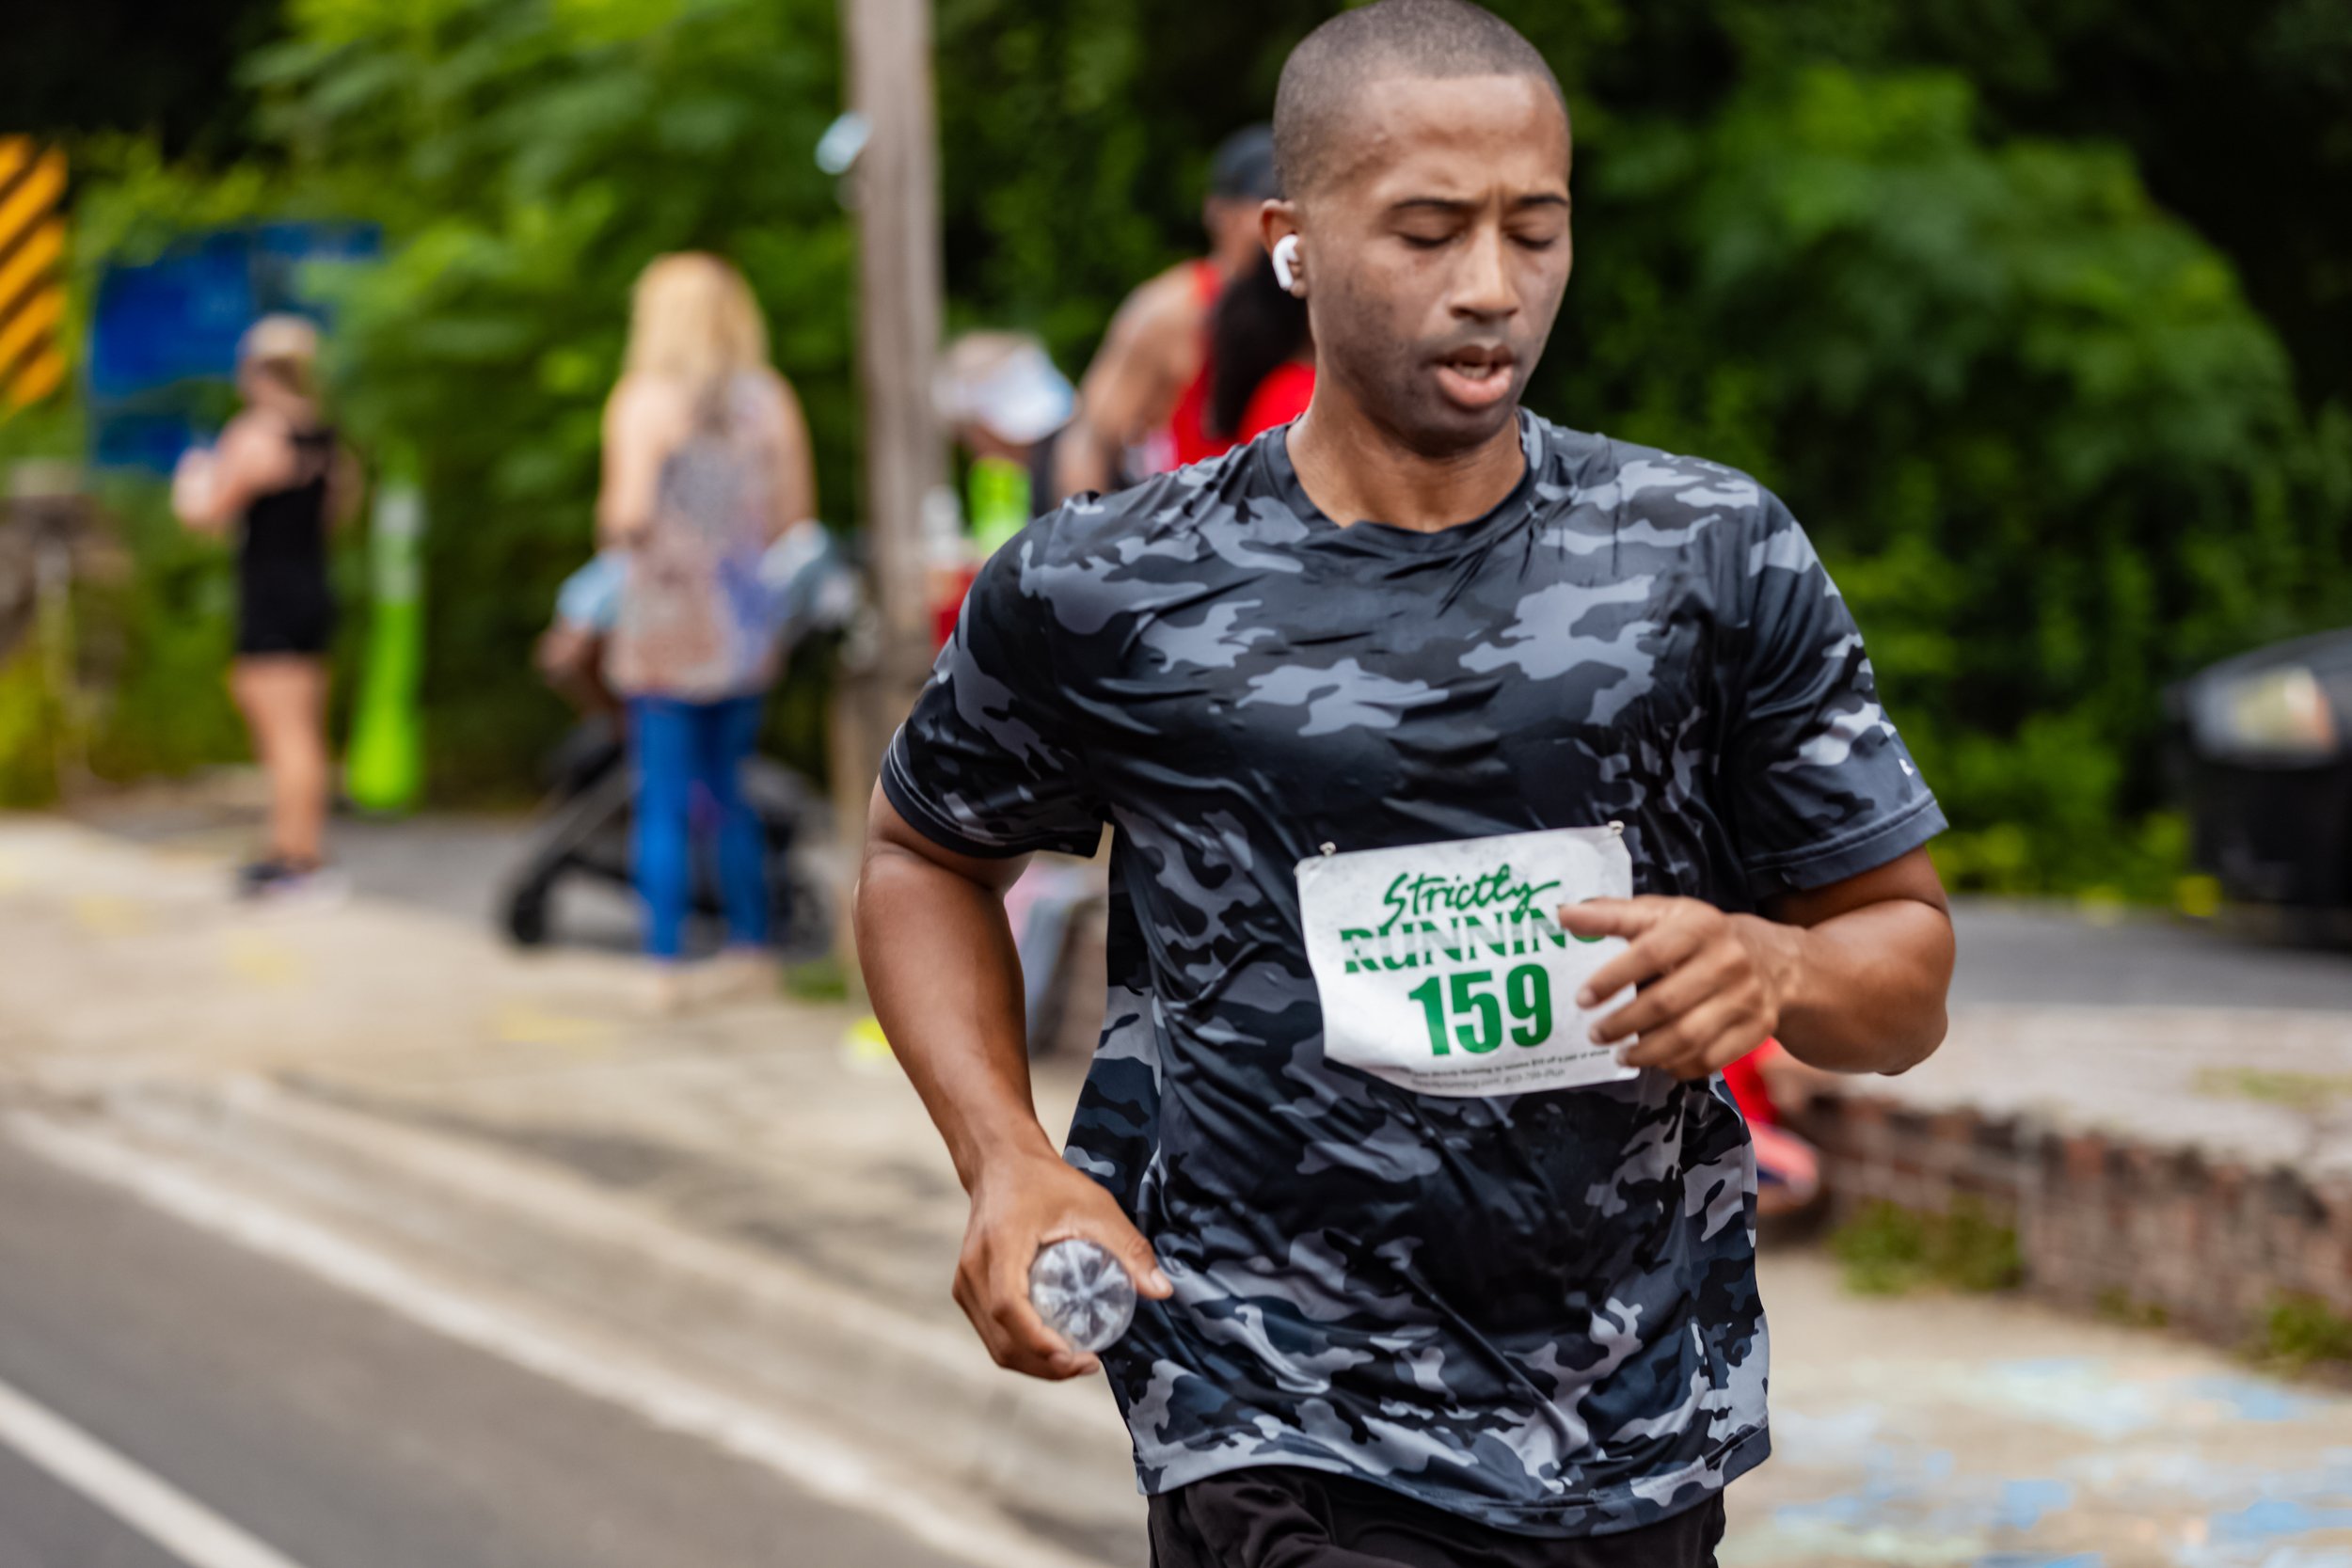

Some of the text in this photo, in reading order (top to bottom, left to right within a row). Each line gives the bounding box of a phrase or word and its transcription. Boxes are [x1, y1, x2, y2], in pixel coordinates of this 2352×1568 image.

[1339, 901, 1607, 974] RUNNIN
[1379, 863, 1561, 938] Strictly
[1408, 963, 1553, 1056] 159
